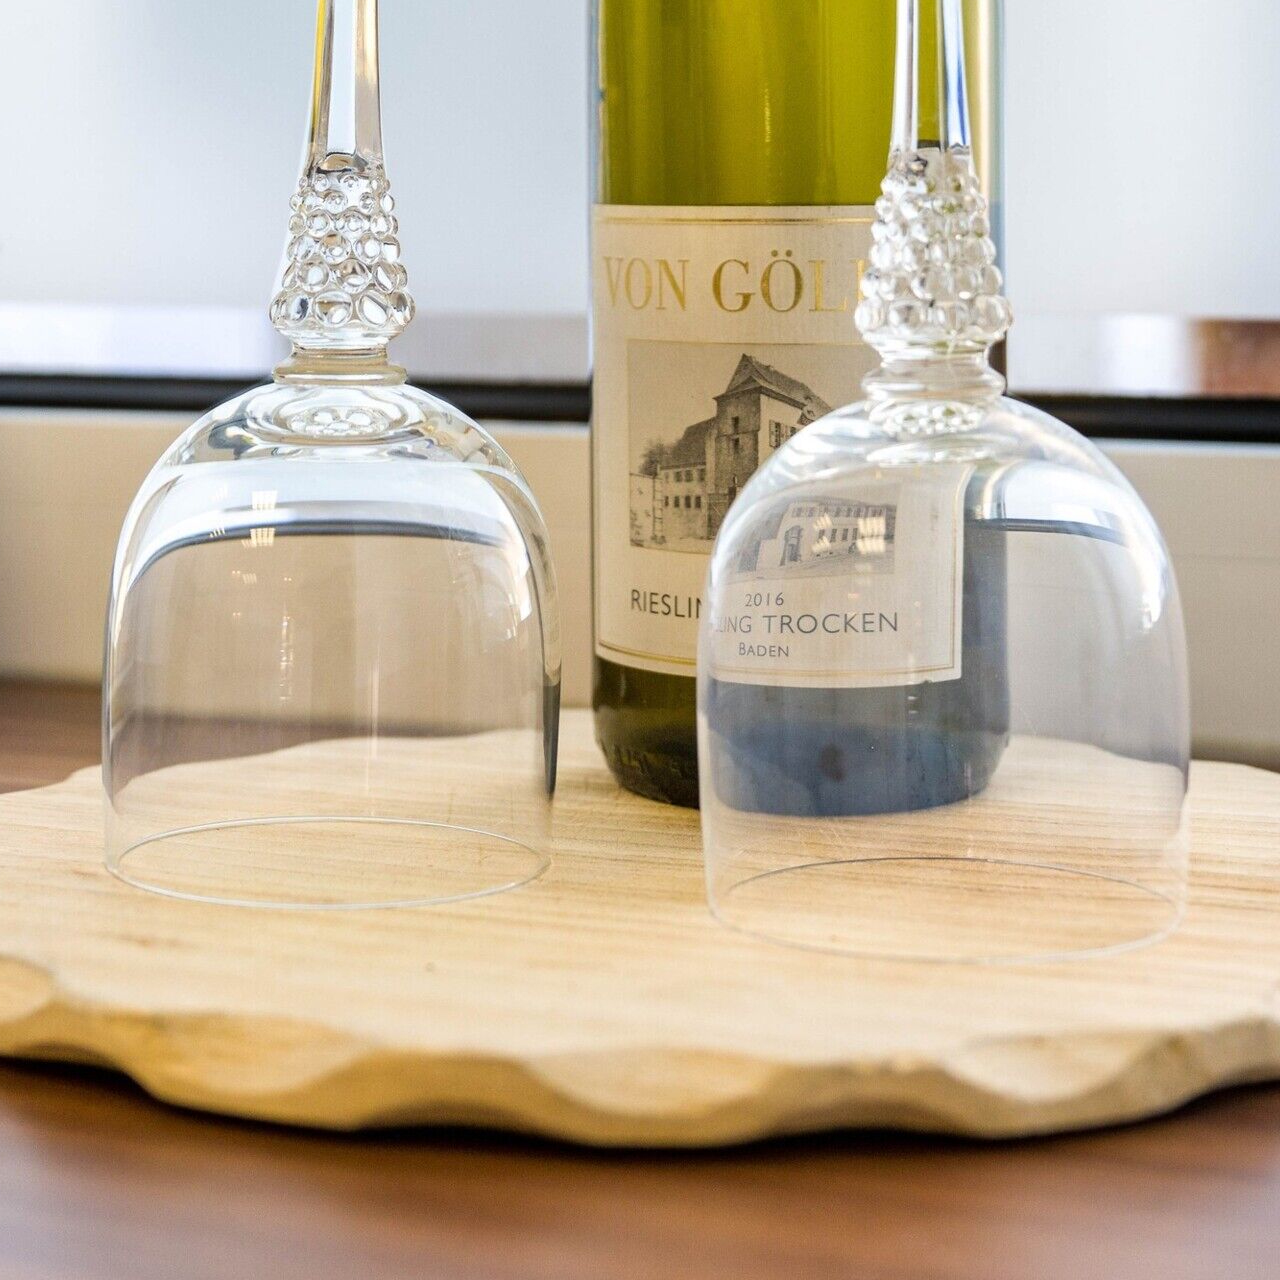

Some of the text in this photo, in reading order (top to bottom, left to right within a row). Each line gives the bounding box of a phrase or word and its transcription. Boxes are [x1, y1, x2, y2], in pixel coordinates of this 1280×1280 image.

[603, 255, 690, 312] VON
[745, 592, 785, 607] 2016
[762, 612, 898, 634] TROCKEN
[738, 642, 789, 658] BADEN
